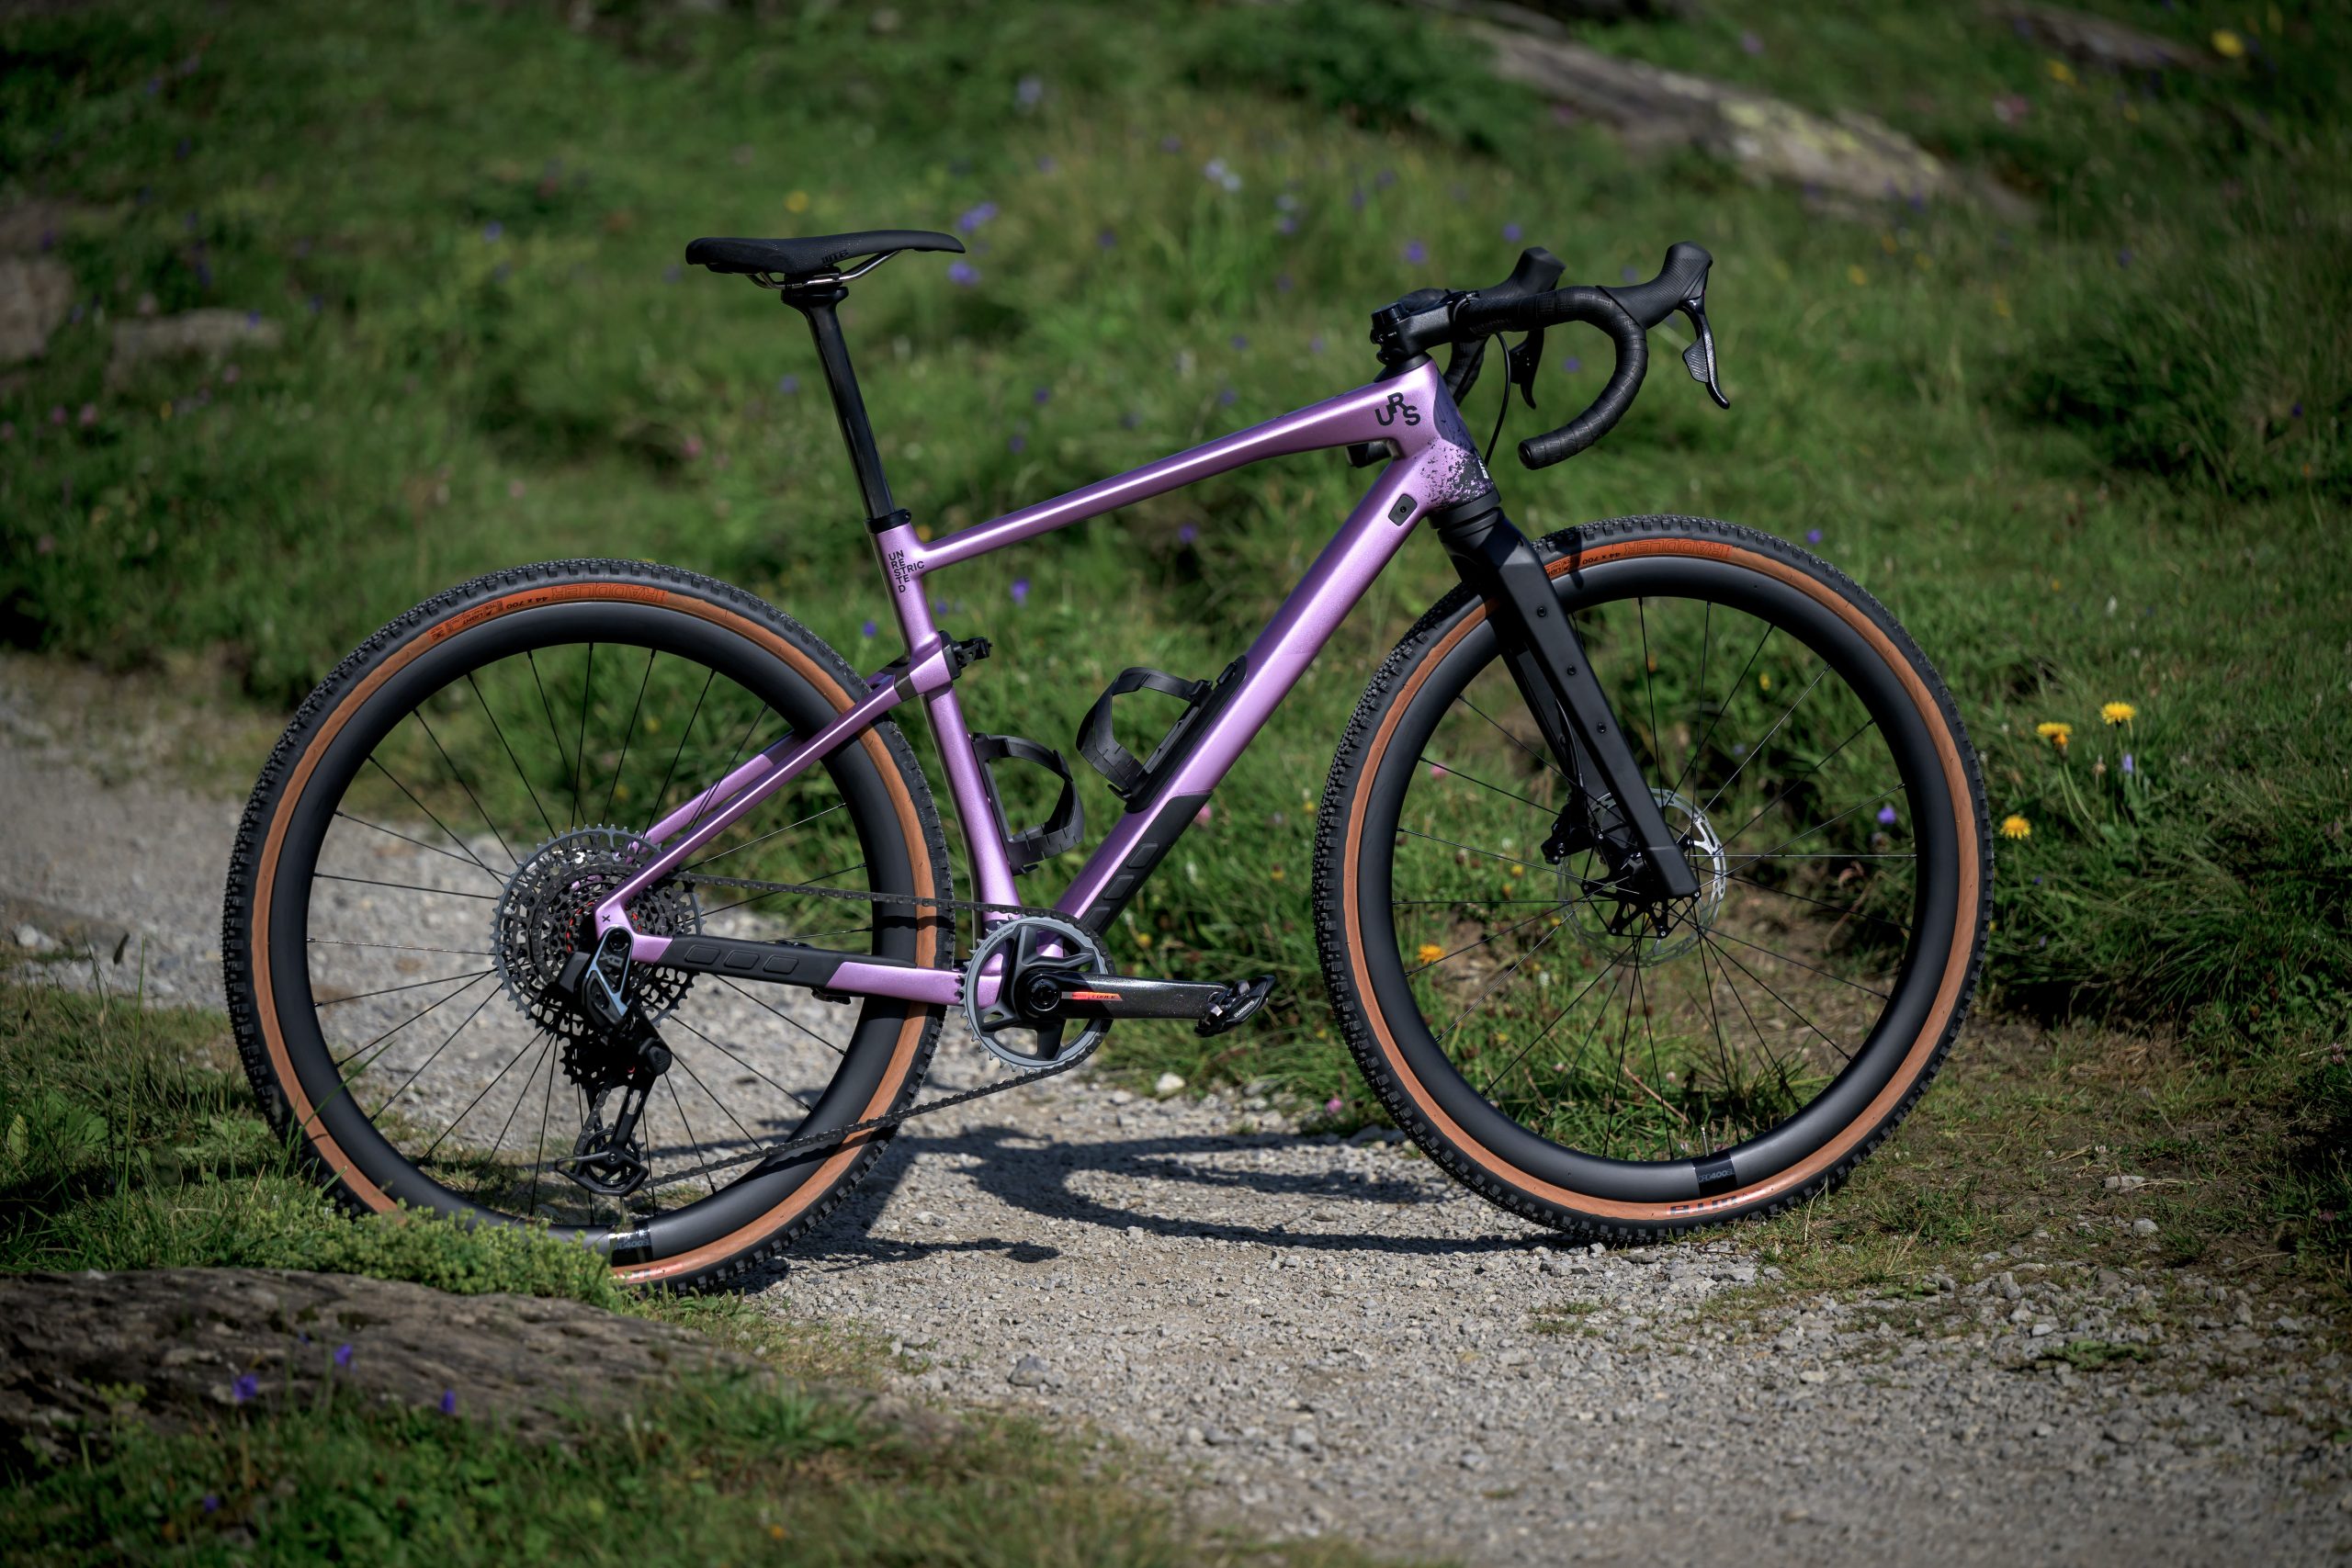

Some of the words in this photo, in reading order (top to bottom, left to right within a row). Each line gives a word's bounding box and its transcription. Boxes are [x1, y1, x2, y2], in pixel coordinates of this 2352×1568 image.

[1374, 392, 1421, 426] URS
[1623, 540, 1724, 558] RADDLER
[888, 550, 904, 561] UN
[1582, 556, 1599, 565] 700
[890, 558, 905, 570] RE
[893, 560, 925, 577] STRIC
[896, 574, 910, 585] TE
[550, 583, 658, 603] RADDLER
[898, 585, 906, 593] D
[505, 601, 525, 609] 700
